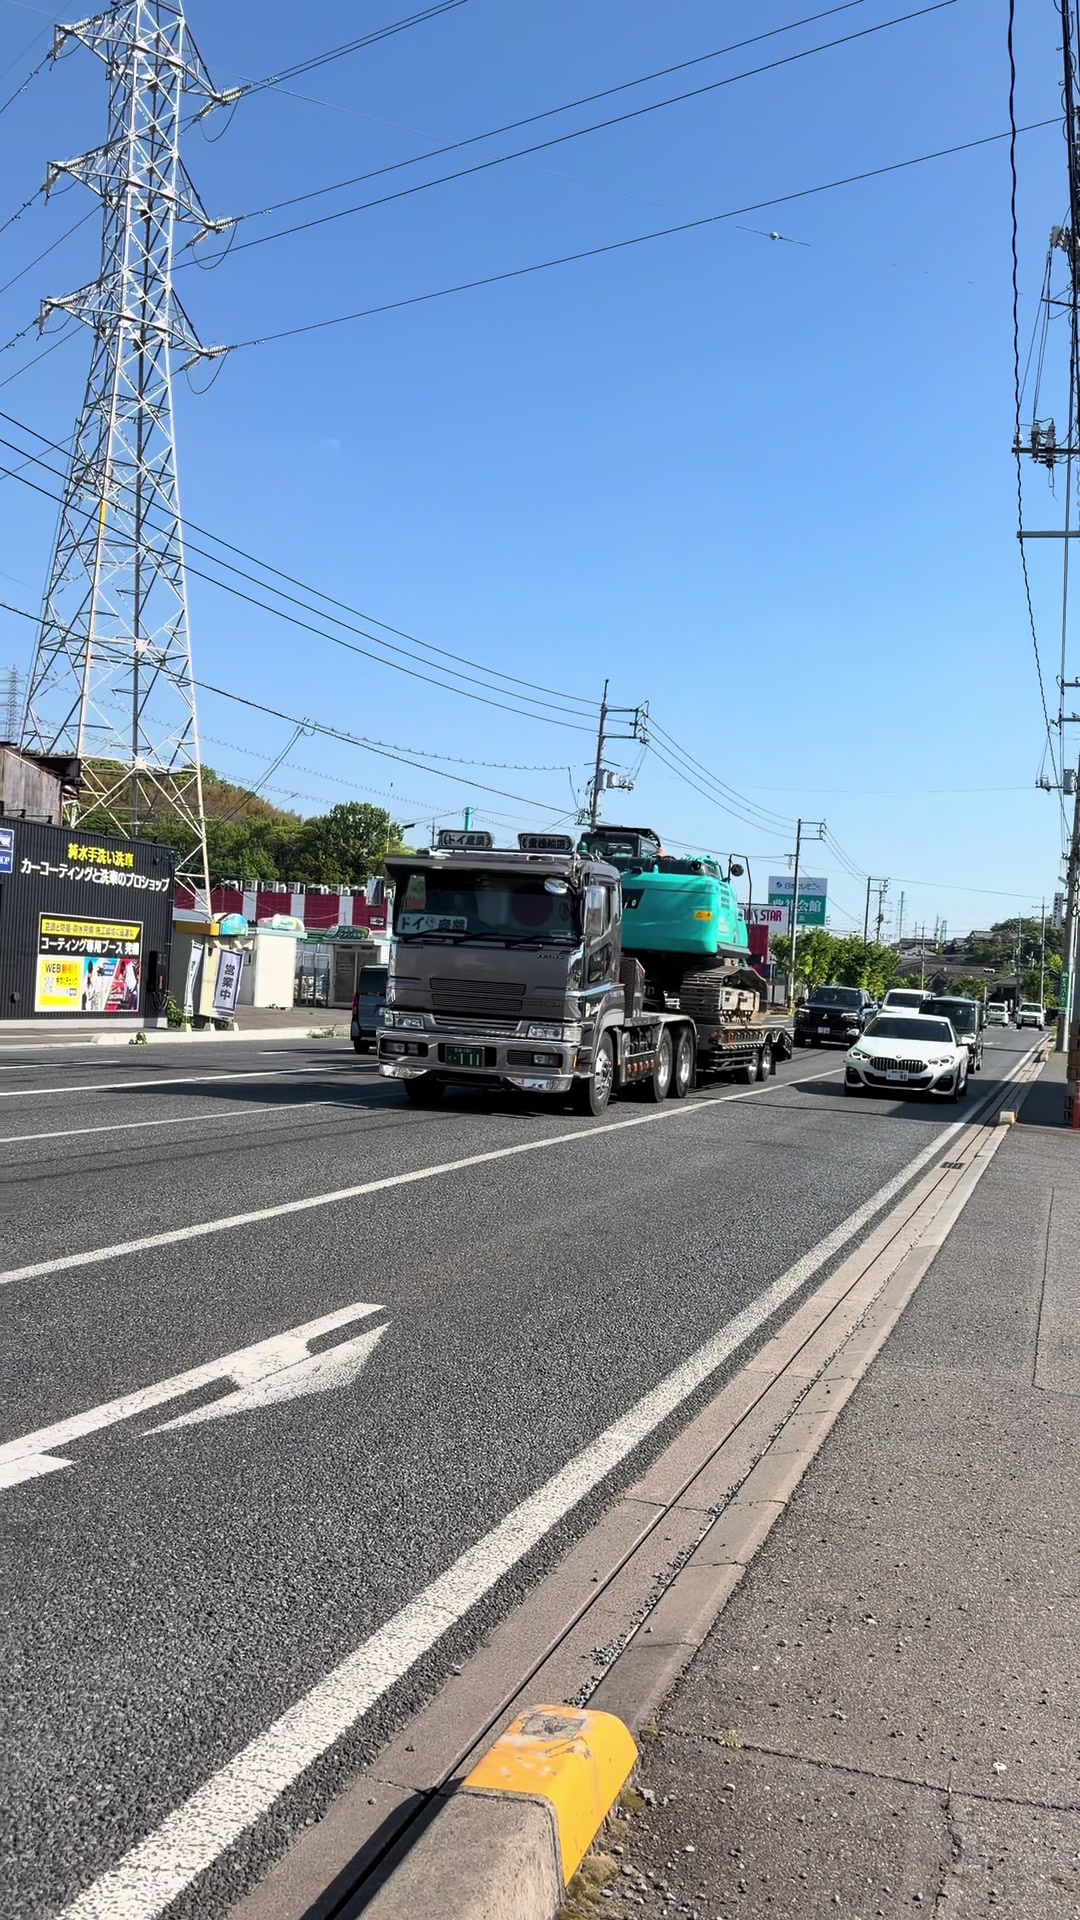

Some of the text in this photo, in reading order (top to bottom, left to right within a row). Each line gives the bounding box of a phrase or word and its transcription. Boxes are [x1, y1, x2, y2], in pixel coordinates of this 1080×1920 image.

[20, 858, 170, 892] カーコーティングと洗車のプロショップ
[760, 909, 783, 922] STAR
[220, 963, 236, 1001] 営業中
